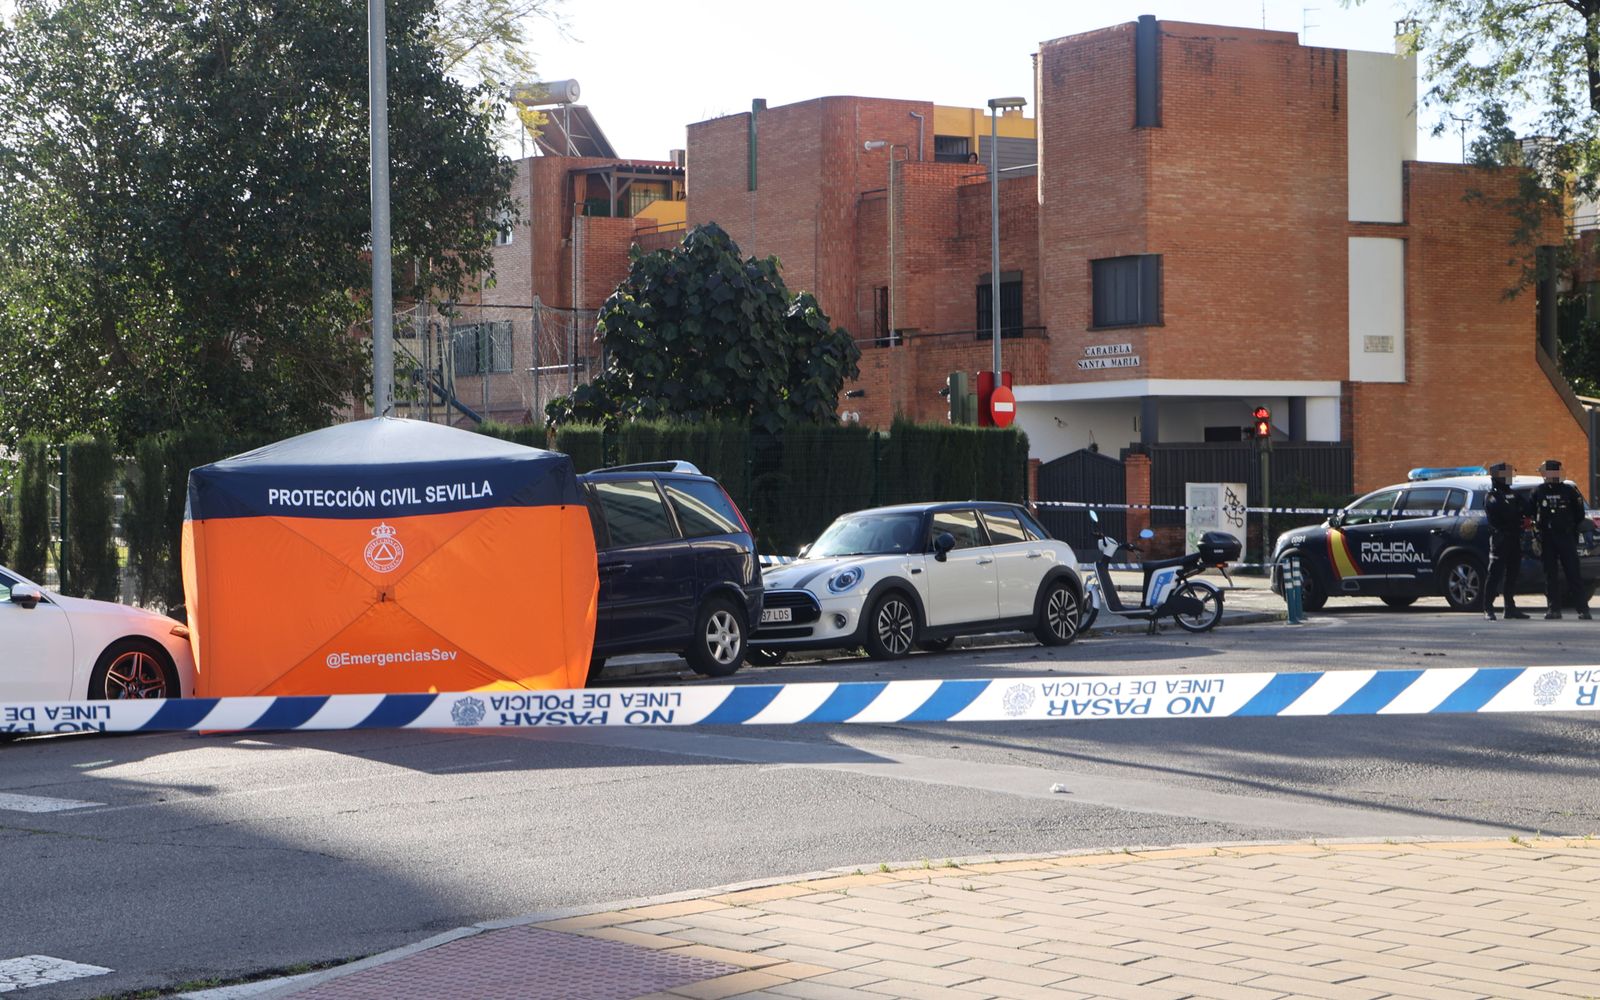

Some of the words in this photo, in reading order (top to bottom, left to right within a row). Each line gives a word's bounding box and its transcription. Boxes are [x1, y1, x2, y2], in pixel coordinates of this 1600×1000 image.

[1085, 345, 1130, 356] CARABELA
[1078, 360, 1106, 369] SANTA
[269, 486, 376, 507] PROTECCIÓN
[381, 488, 421, 506] CIVIL
[426, 480, 493, 503] SEVILLA
[1361, 540, 1415, 553] POLICÍA
[1361, 553, 1431, 563] NACIONAL
[773, 609, 789, 620] LDS
[326, 649, 457, 669] @EmergenciasSev
[1041, 682, 1121, 697] POLICIA
[1129, 680, 1157, 695] DE
[1166, 679, 1225, 694] LINEA
[489, 694, 574, 710] POLICIA
[582, 693, 611, 708] DE
[620, 692, 682, 707] LINEA
[1047, 697, 1152, 716] PASAR
[1166, 696, 1216, 714] NO
[4, 707, 36, 721] DE
[44, 705, 111, 720] LINEA
[500, 710, 609, 726] PASAR
[624, 709, 675, 724] NO
